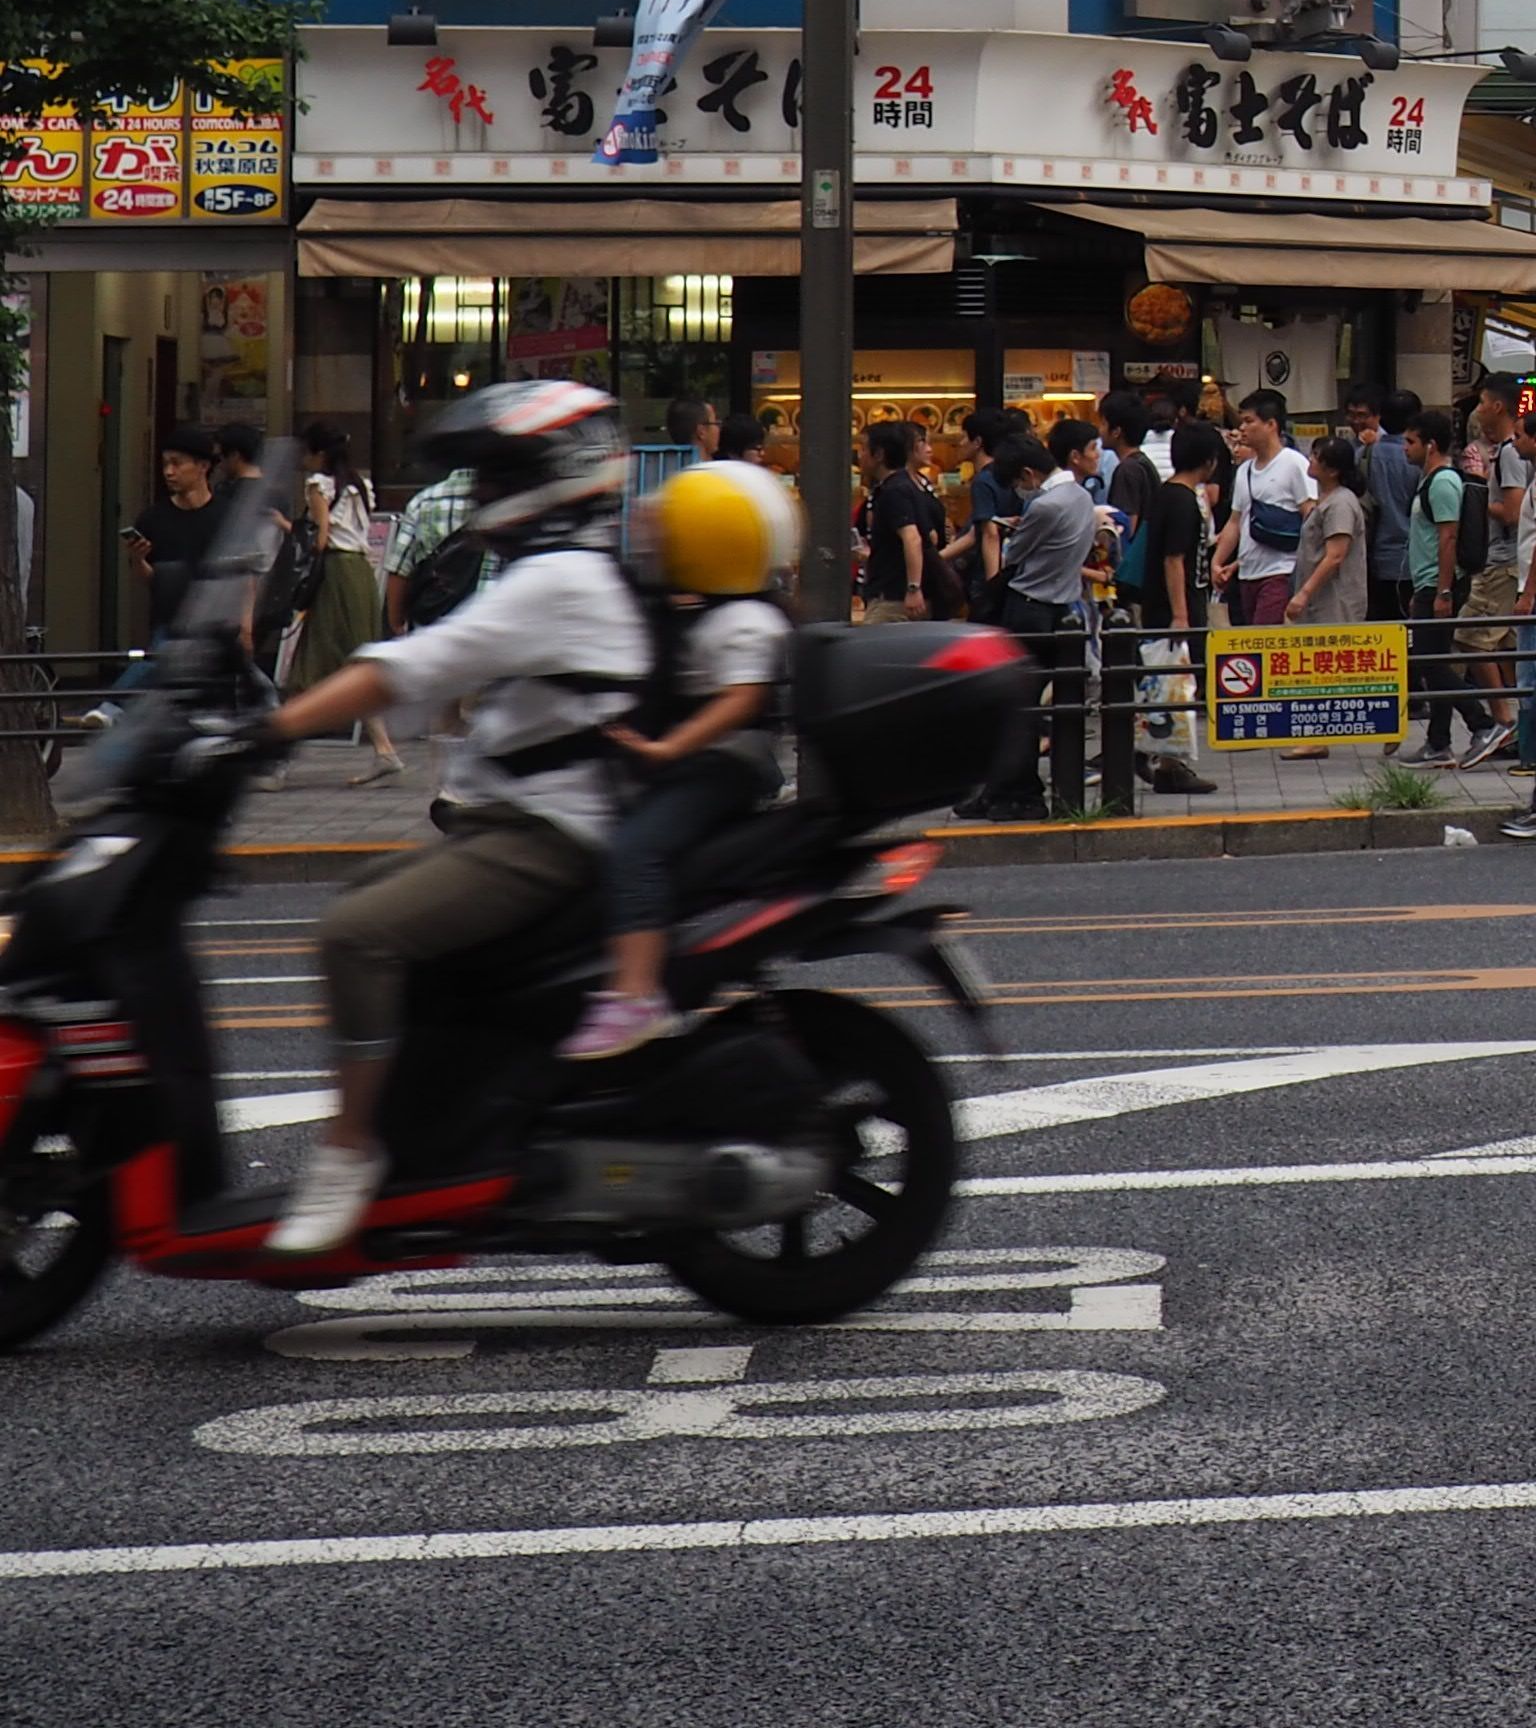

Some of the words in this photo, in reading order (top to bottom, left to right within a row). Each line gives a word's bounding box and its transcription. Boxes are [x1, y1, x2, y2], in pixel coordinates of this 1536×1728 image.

[419, 55, 494, 125] 名代
[528, 46, 803, 138] 富そ
[874, 66, 934, 100] 24
[873, 101, 934, 130] 時間
[1107, 69, 1159, 136] 名代
[1177, 64, 1375, 150] 富士そば
[1389, 95, 1425, 128] 24
[142, 117, 181, 131] HOURS
[194, 138, 279, 155] コムコム
[1386, 127, 1423, 156] 時間
[194, 157, 279, 176] 秋葉原店
[1228, 633, 1383, 651] 千代田区生活環境条例により
[1269, 648, 1399, 677] 路上喫煙禁止
[1222, 704, 1238, 715] NO
[1238, 702, 1284, 715] SMOKING
[1290, 700, 1316, 713] fine
[1317, 700, 1331, 712] of
[1334, 699, 1365, 710] 2000
[1367, 700, 1391, 712] yen
